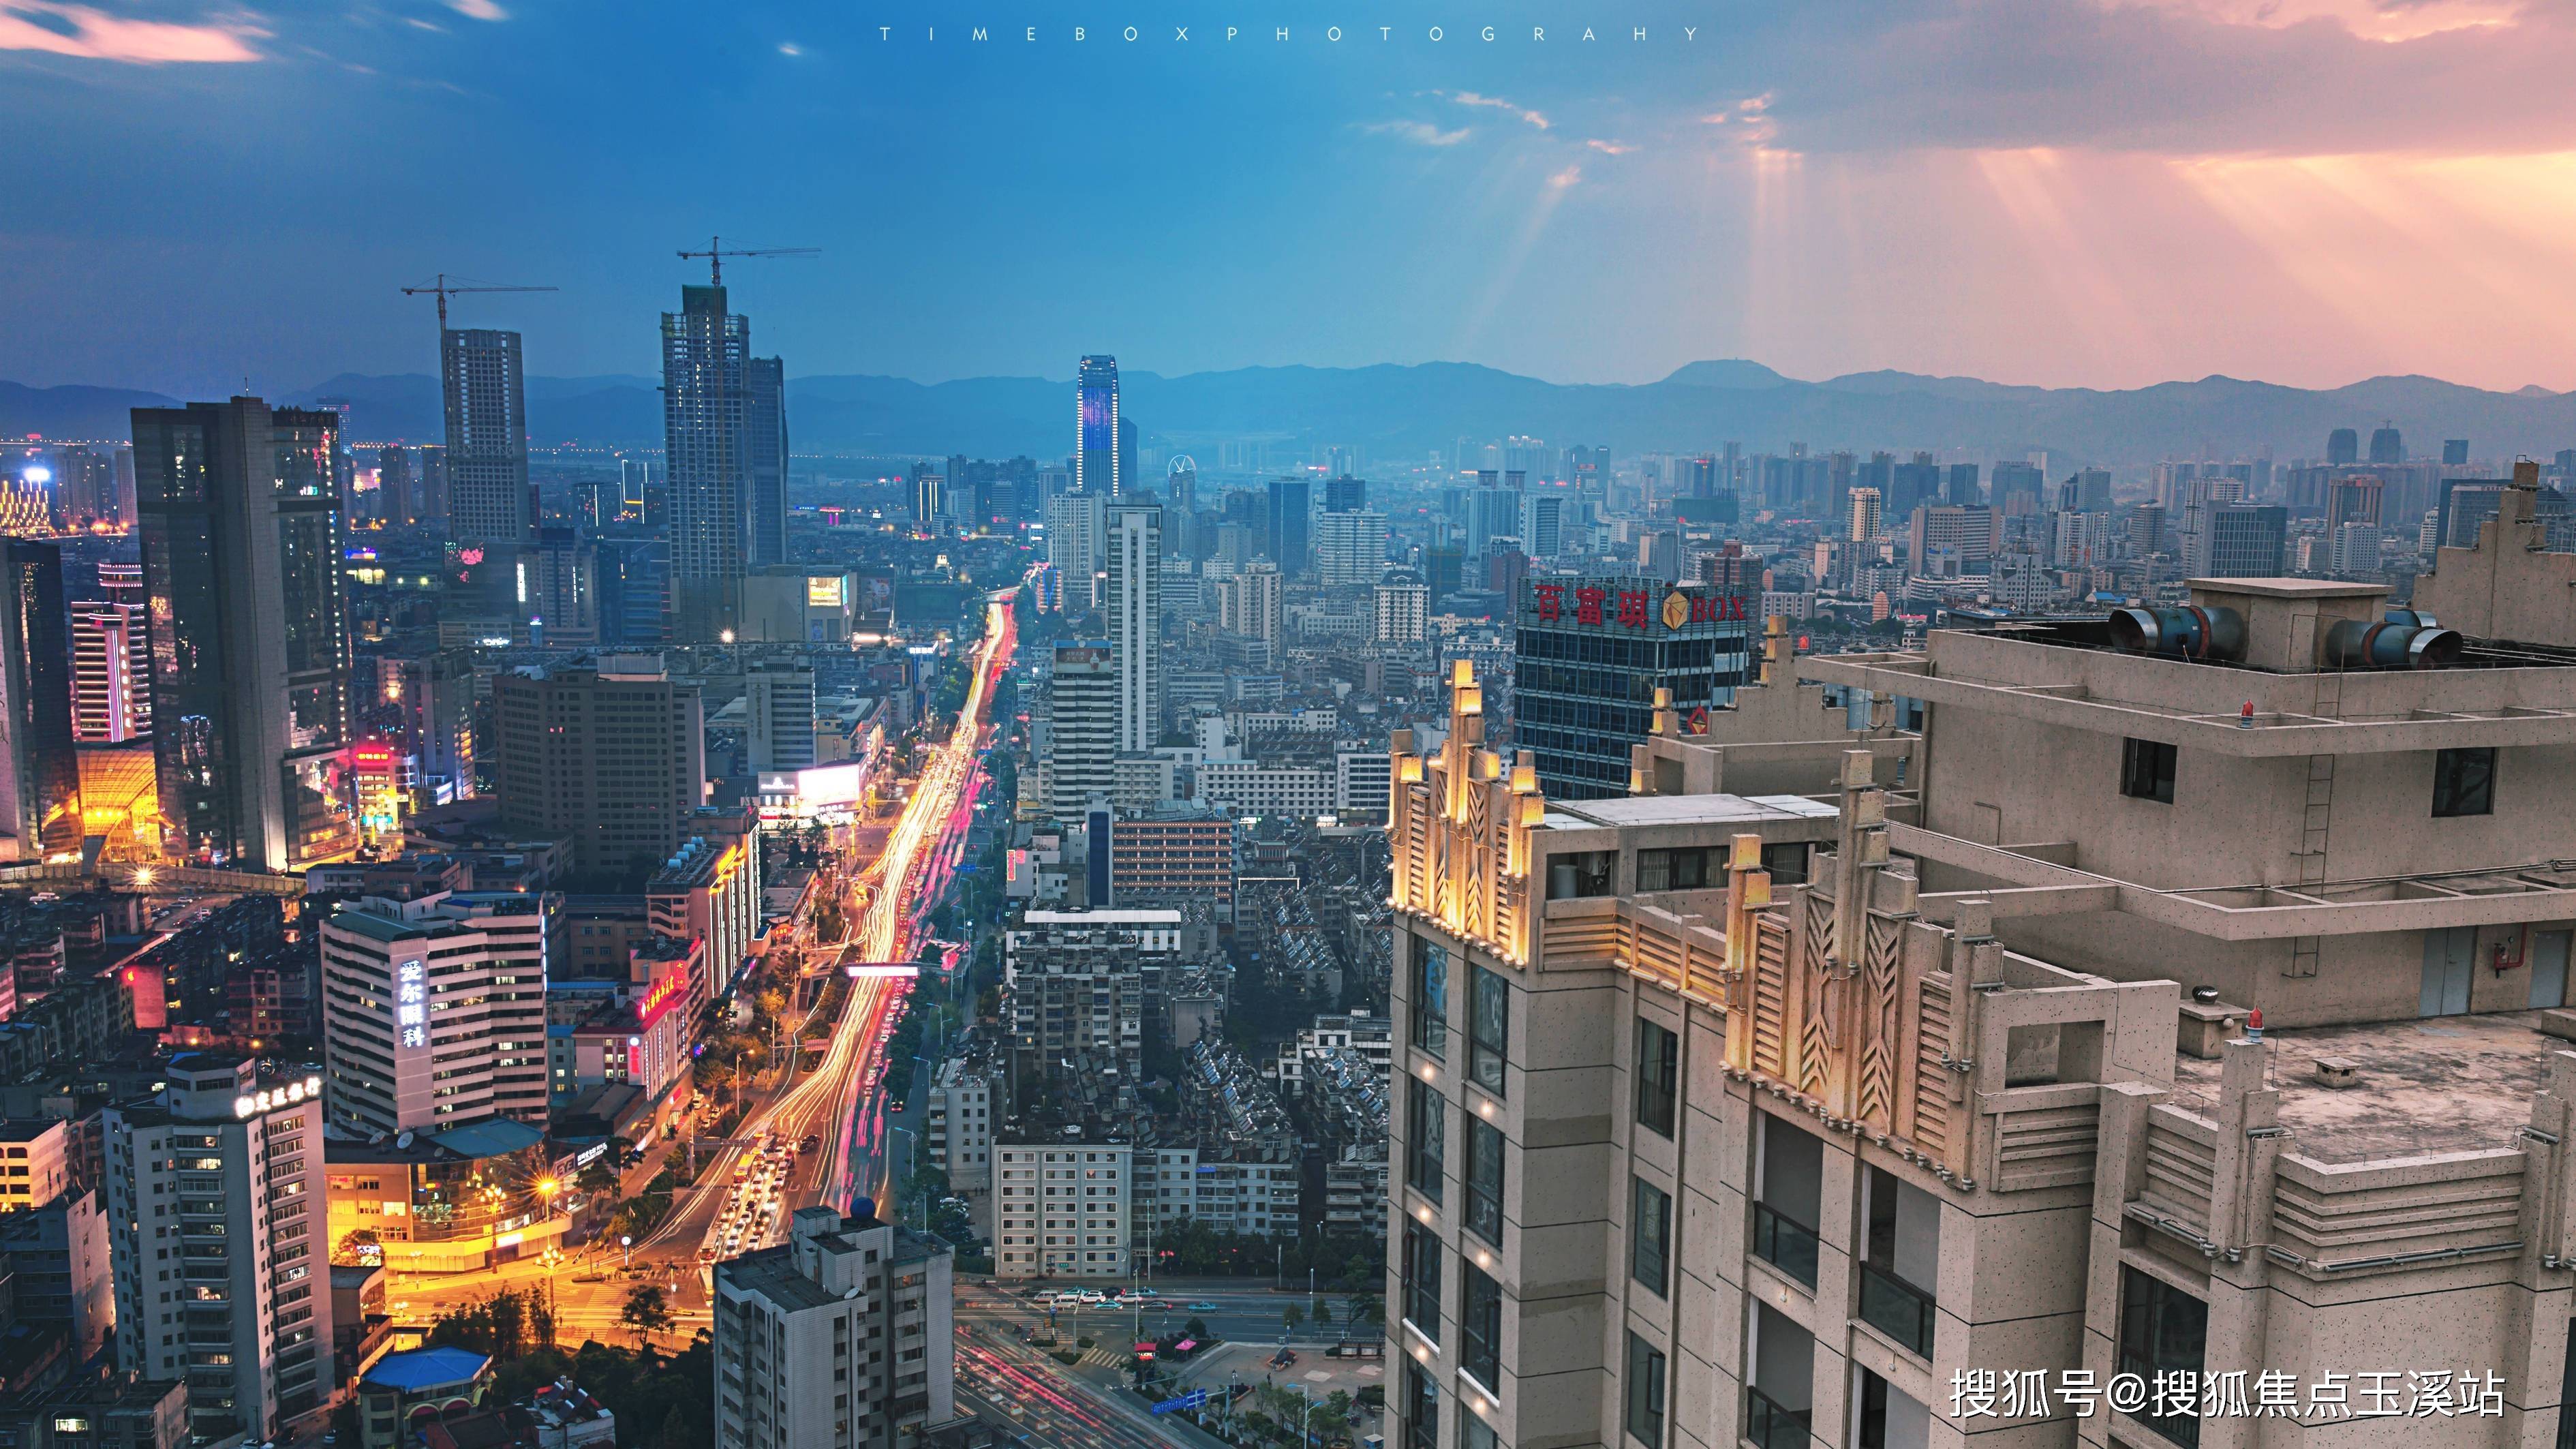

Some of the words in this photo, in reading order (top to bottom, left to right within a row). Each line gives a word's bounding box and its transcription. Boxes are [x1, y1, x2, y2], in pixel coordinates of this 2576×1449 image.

[1535, 584, 1649, 630] 百富琪
[1691, 596, 1748, 622] BOX
[399, 960, 425, 1048] 爱尔眼科
